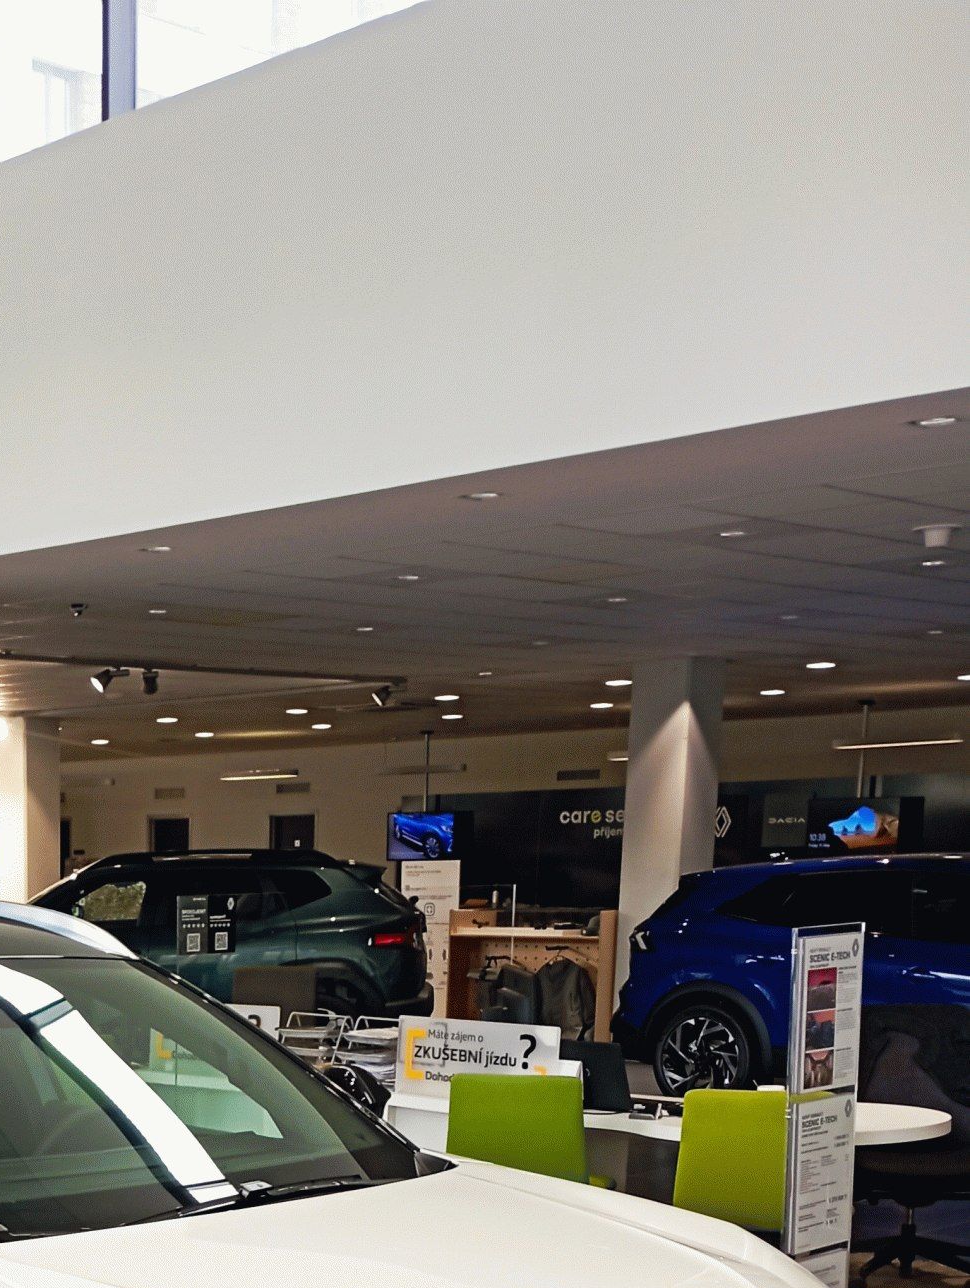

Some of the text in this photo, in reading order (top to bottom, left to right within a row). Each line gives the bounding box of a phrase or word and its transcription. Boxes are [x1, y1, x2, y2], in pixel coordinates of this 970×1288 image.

[560, 810, 602, 824] care
[428, 1029, 448, 1040] Máte
[451, 1031, 476, 1044] zájem
[414, 1043, 483, 1064] ZKUŠEBNÍ
[484, 1051, 517, 1068] jízdu
